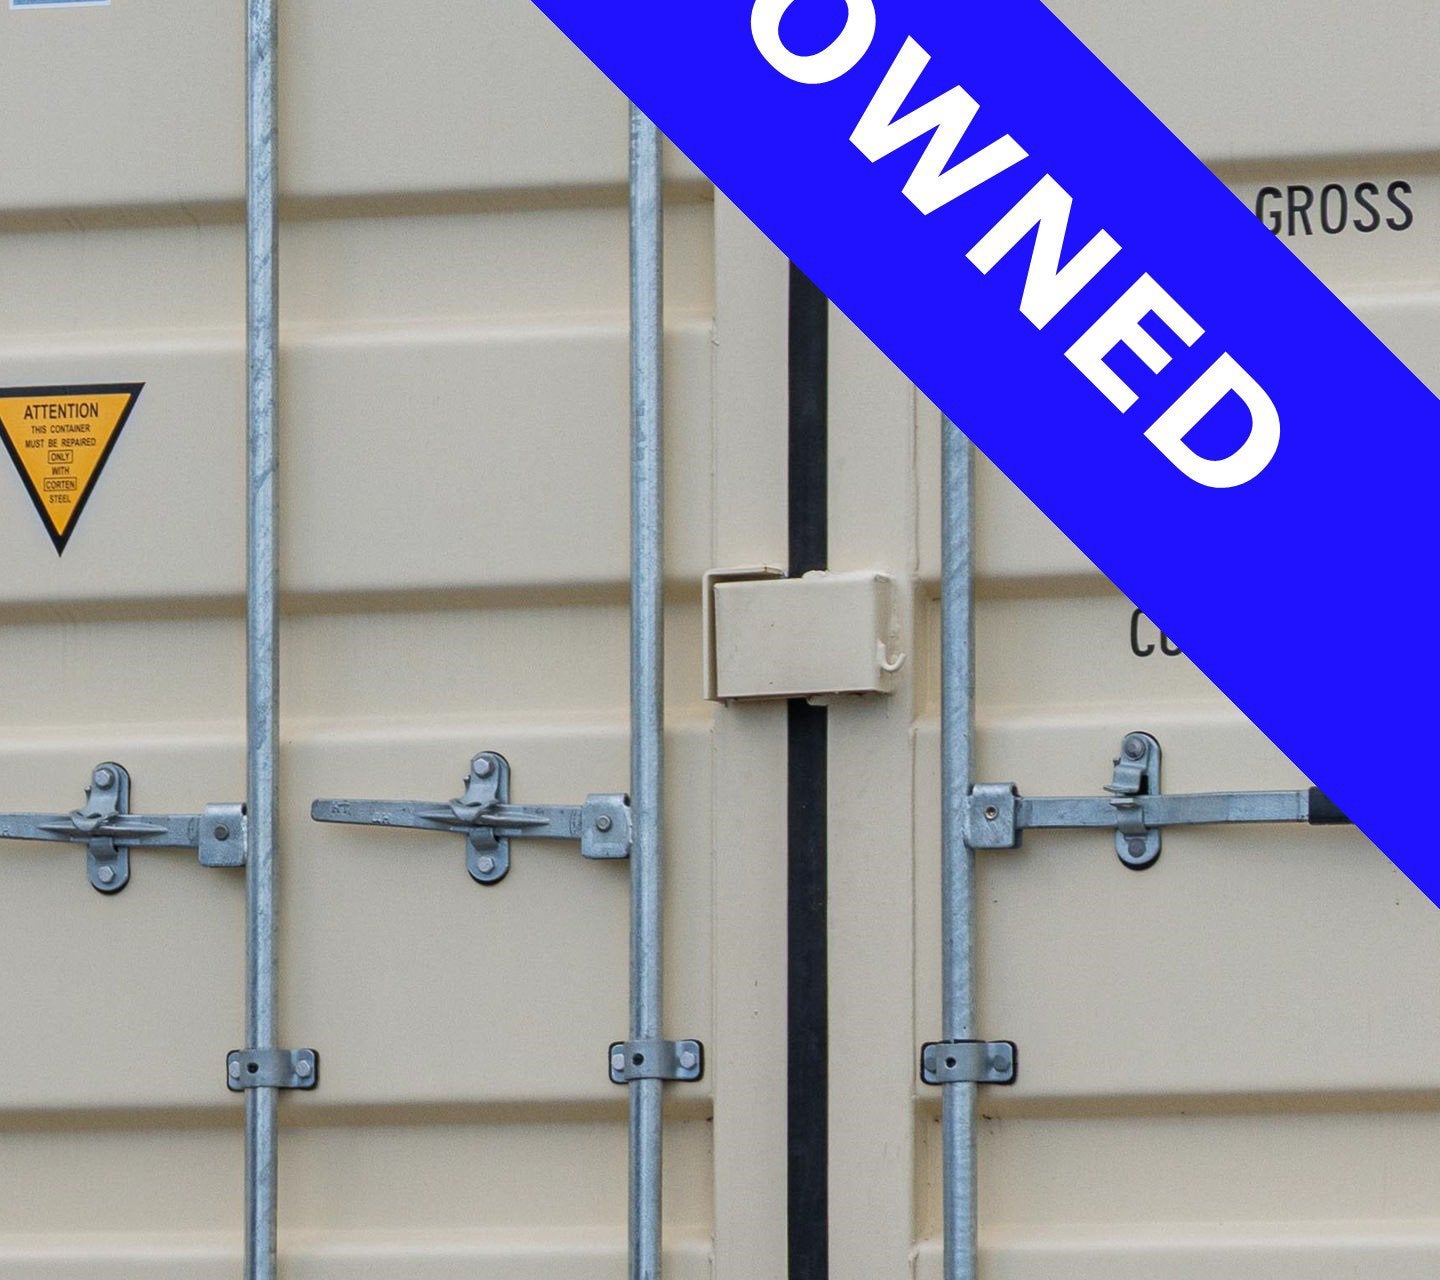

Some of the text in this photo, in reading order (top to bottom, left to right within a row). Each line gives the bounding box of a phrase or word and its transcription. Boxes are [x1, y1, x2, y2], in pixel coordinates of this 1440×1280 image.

[1254, 180, 1414, 237] GROSS
[23, 402, 99, 420] ATTENTION
[31, 424, 91, 434] THIS CONTAINER
[25, 438, 97, 448] MUST BE REPAIRED
[51, 452, 70, 461] ONLY
[52, 466, 70, 476] WITH
[45, 480, 75, 490] CORTEN
[49, 494, 71, 503] STEEL
